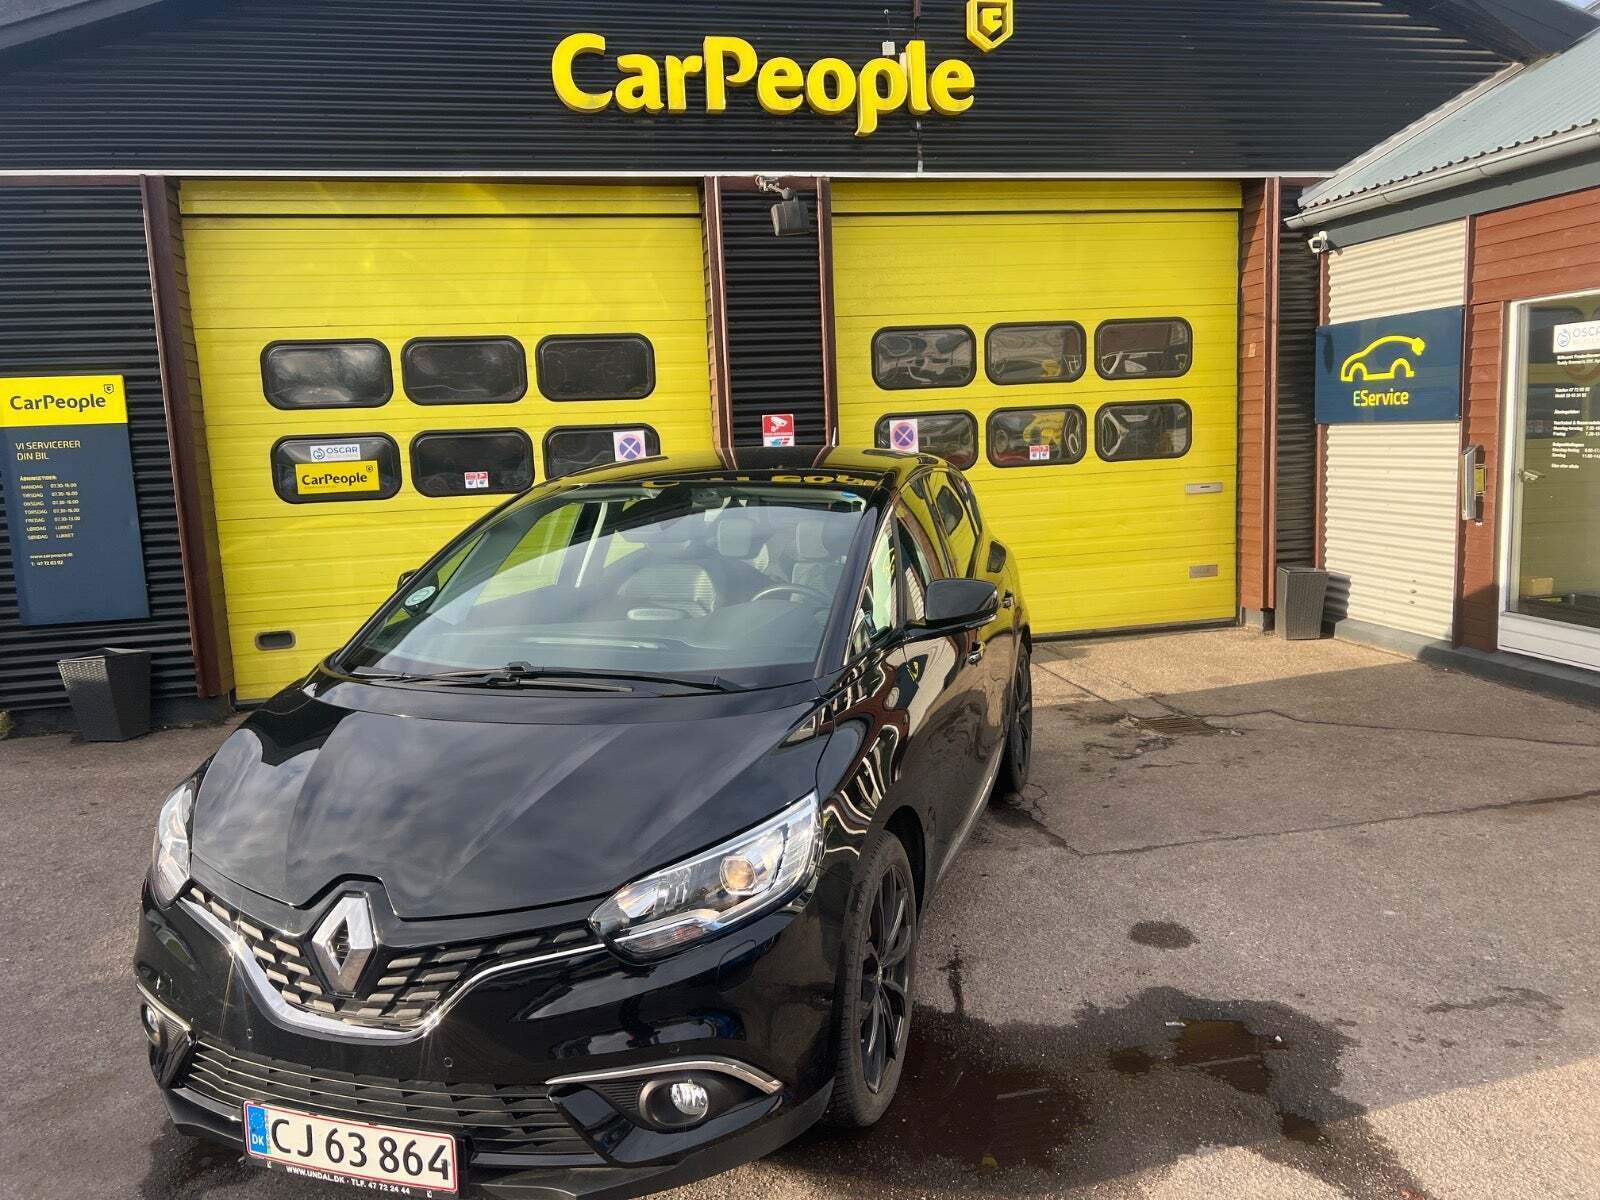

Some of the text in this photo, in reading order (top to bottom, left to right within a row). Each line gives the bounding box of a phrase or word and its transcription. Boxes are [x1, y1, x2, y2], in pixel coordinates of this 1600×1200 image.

[551, 32, 976, 137] CarPeople
[9, 393, 107, 412] CarPeople
[1353, 388, 1409, 407] EService
[26, 440, 81, 450] SERVICERER
[326, 446, 358, 454] OSCAR
[16, 452, 50, 461] DIN BIL
[301, 472, 368, 486] CarPeople
[252, 1134, 264, 1145] DK
[271, 1118, 449, 1180] CJ 63 864
